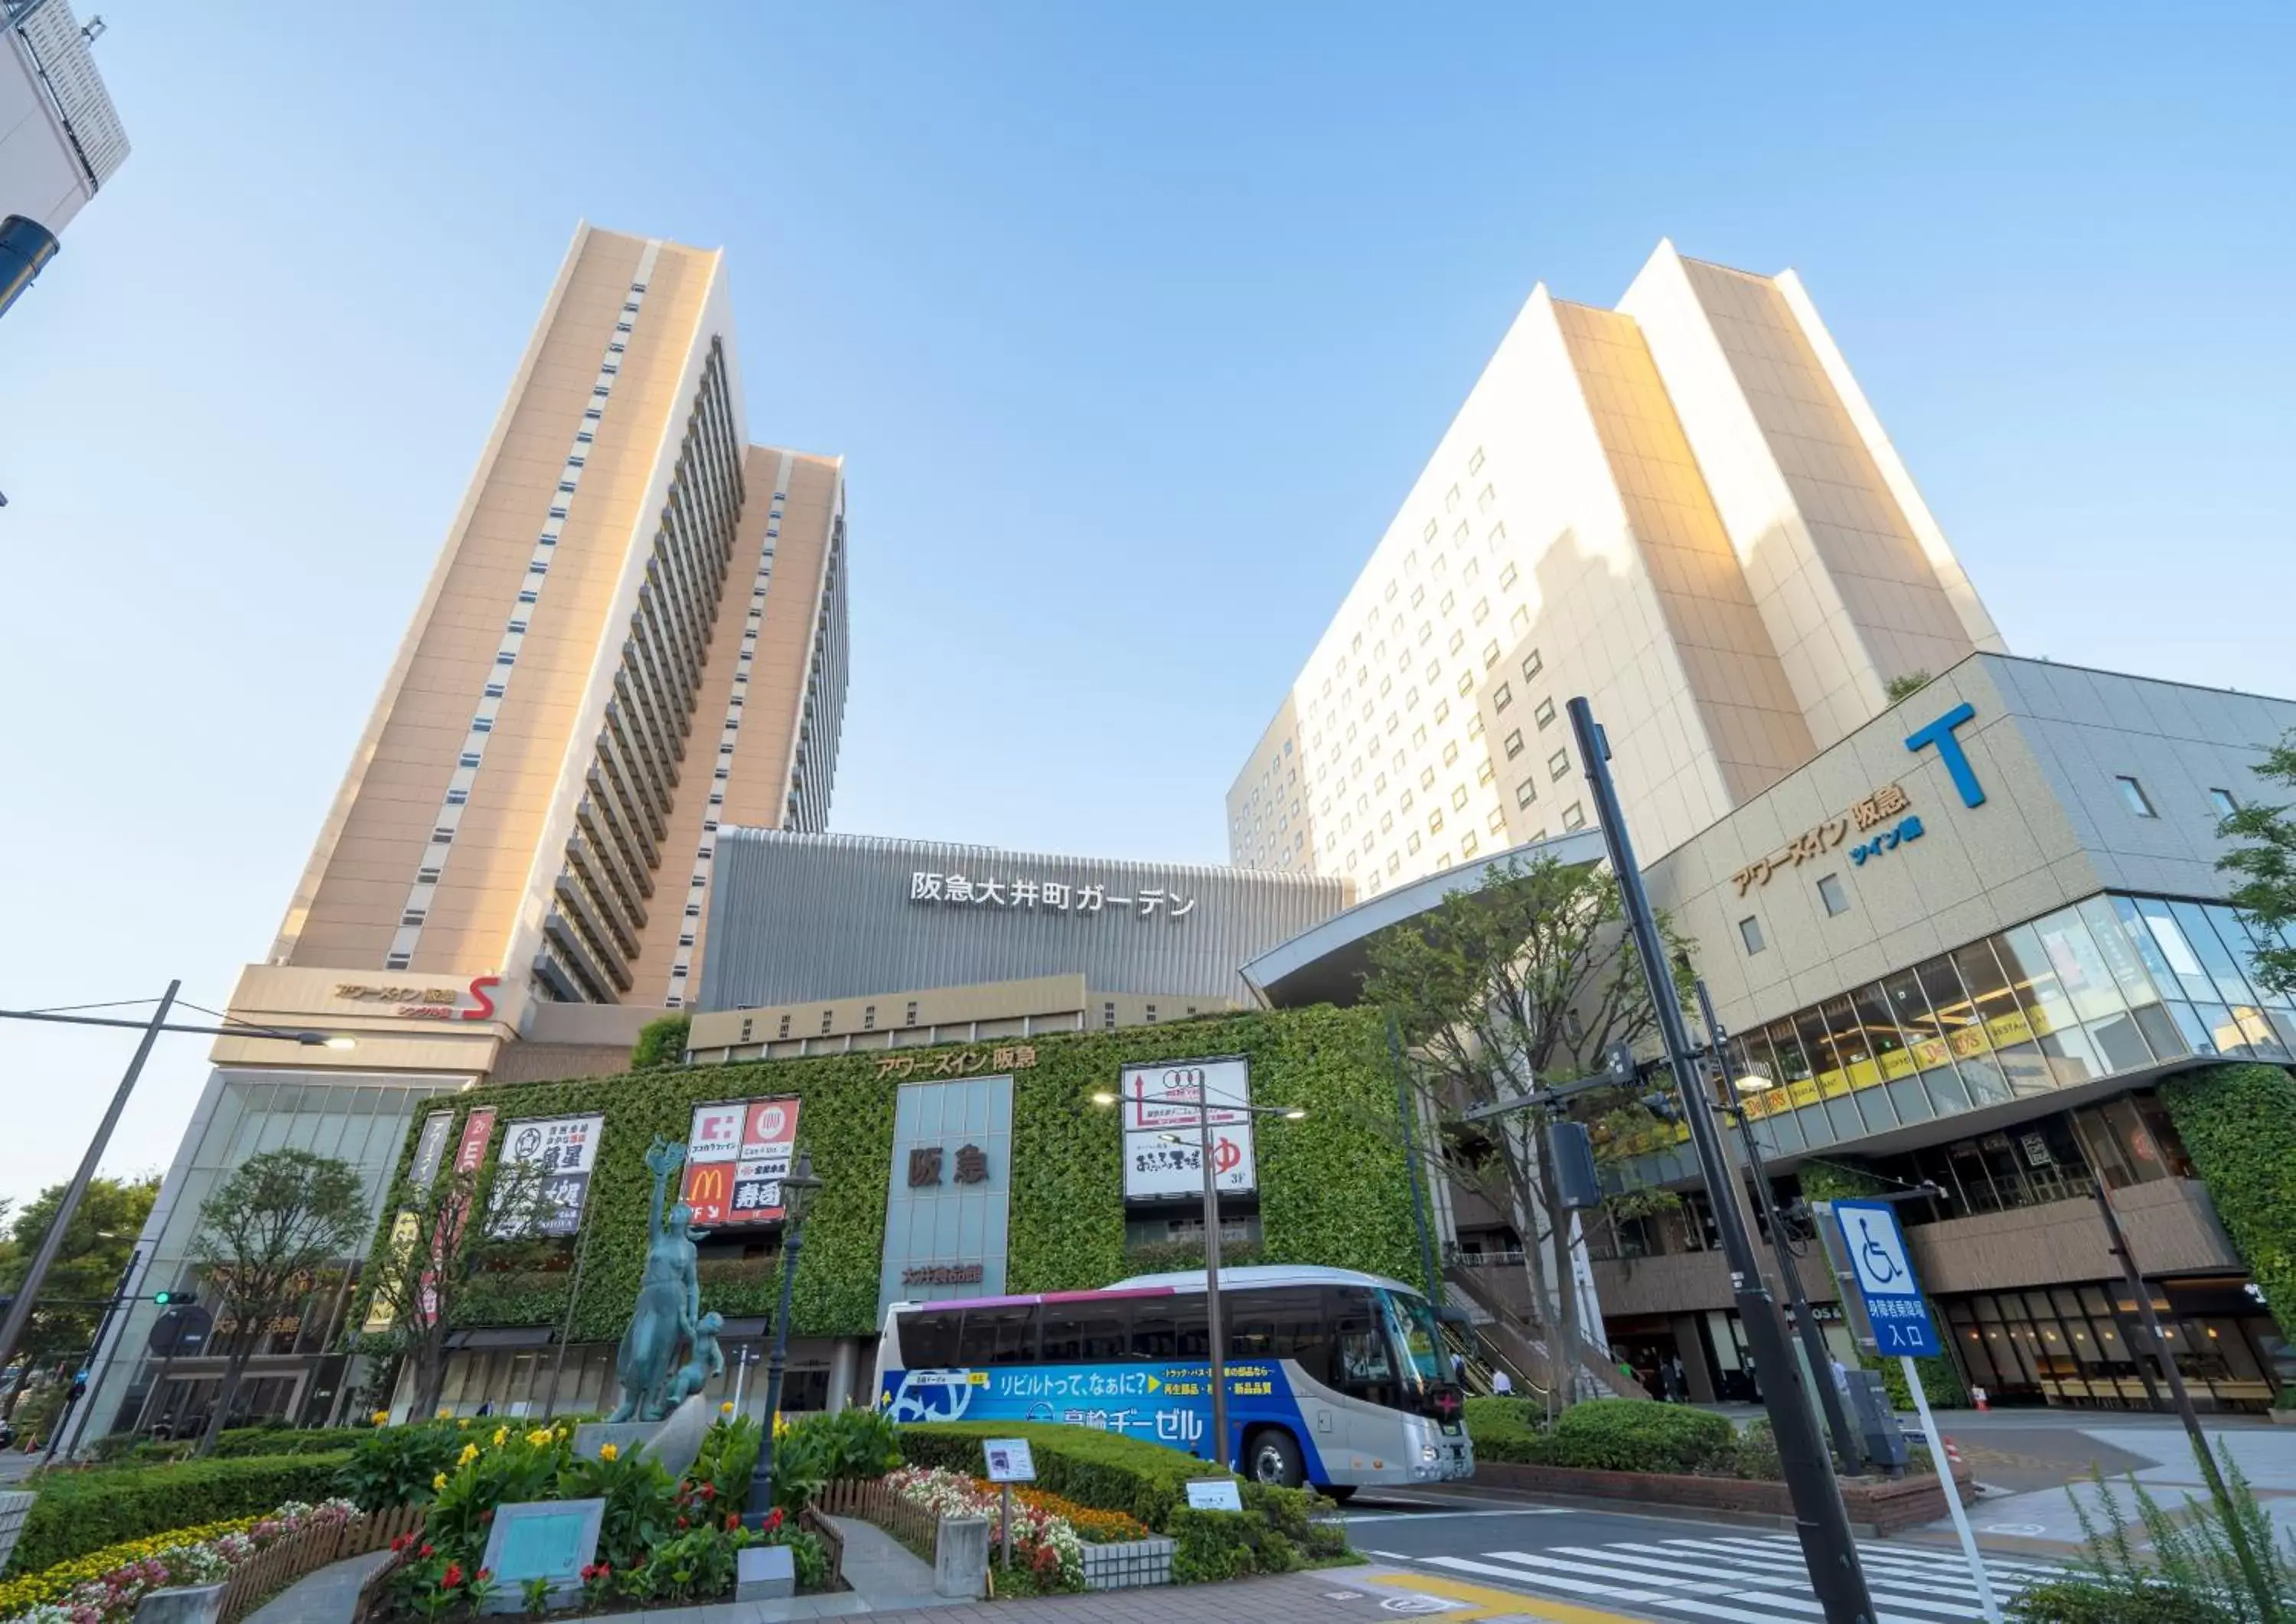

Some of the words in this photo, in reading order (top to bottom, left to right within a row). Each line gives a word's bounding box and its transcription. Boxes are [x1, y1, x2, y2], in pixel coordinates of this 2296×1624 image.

[1903, 702, 1986, 808] T
[1730, 819, 1848, 897] アワーズイン
[1850, 782, 1912, 832] 阪急
[909, 871, 1195, 917] 阪急大井町ガーデン
[462, 977, 502, 1019] S
[876, 1052, 987, 1080] アワーズイン
[993, 1046, 1037, 1071] 阪急
[908, 1143, 990, 1188] 阪急
[1888, 1325, 1924, 1347] 入口
